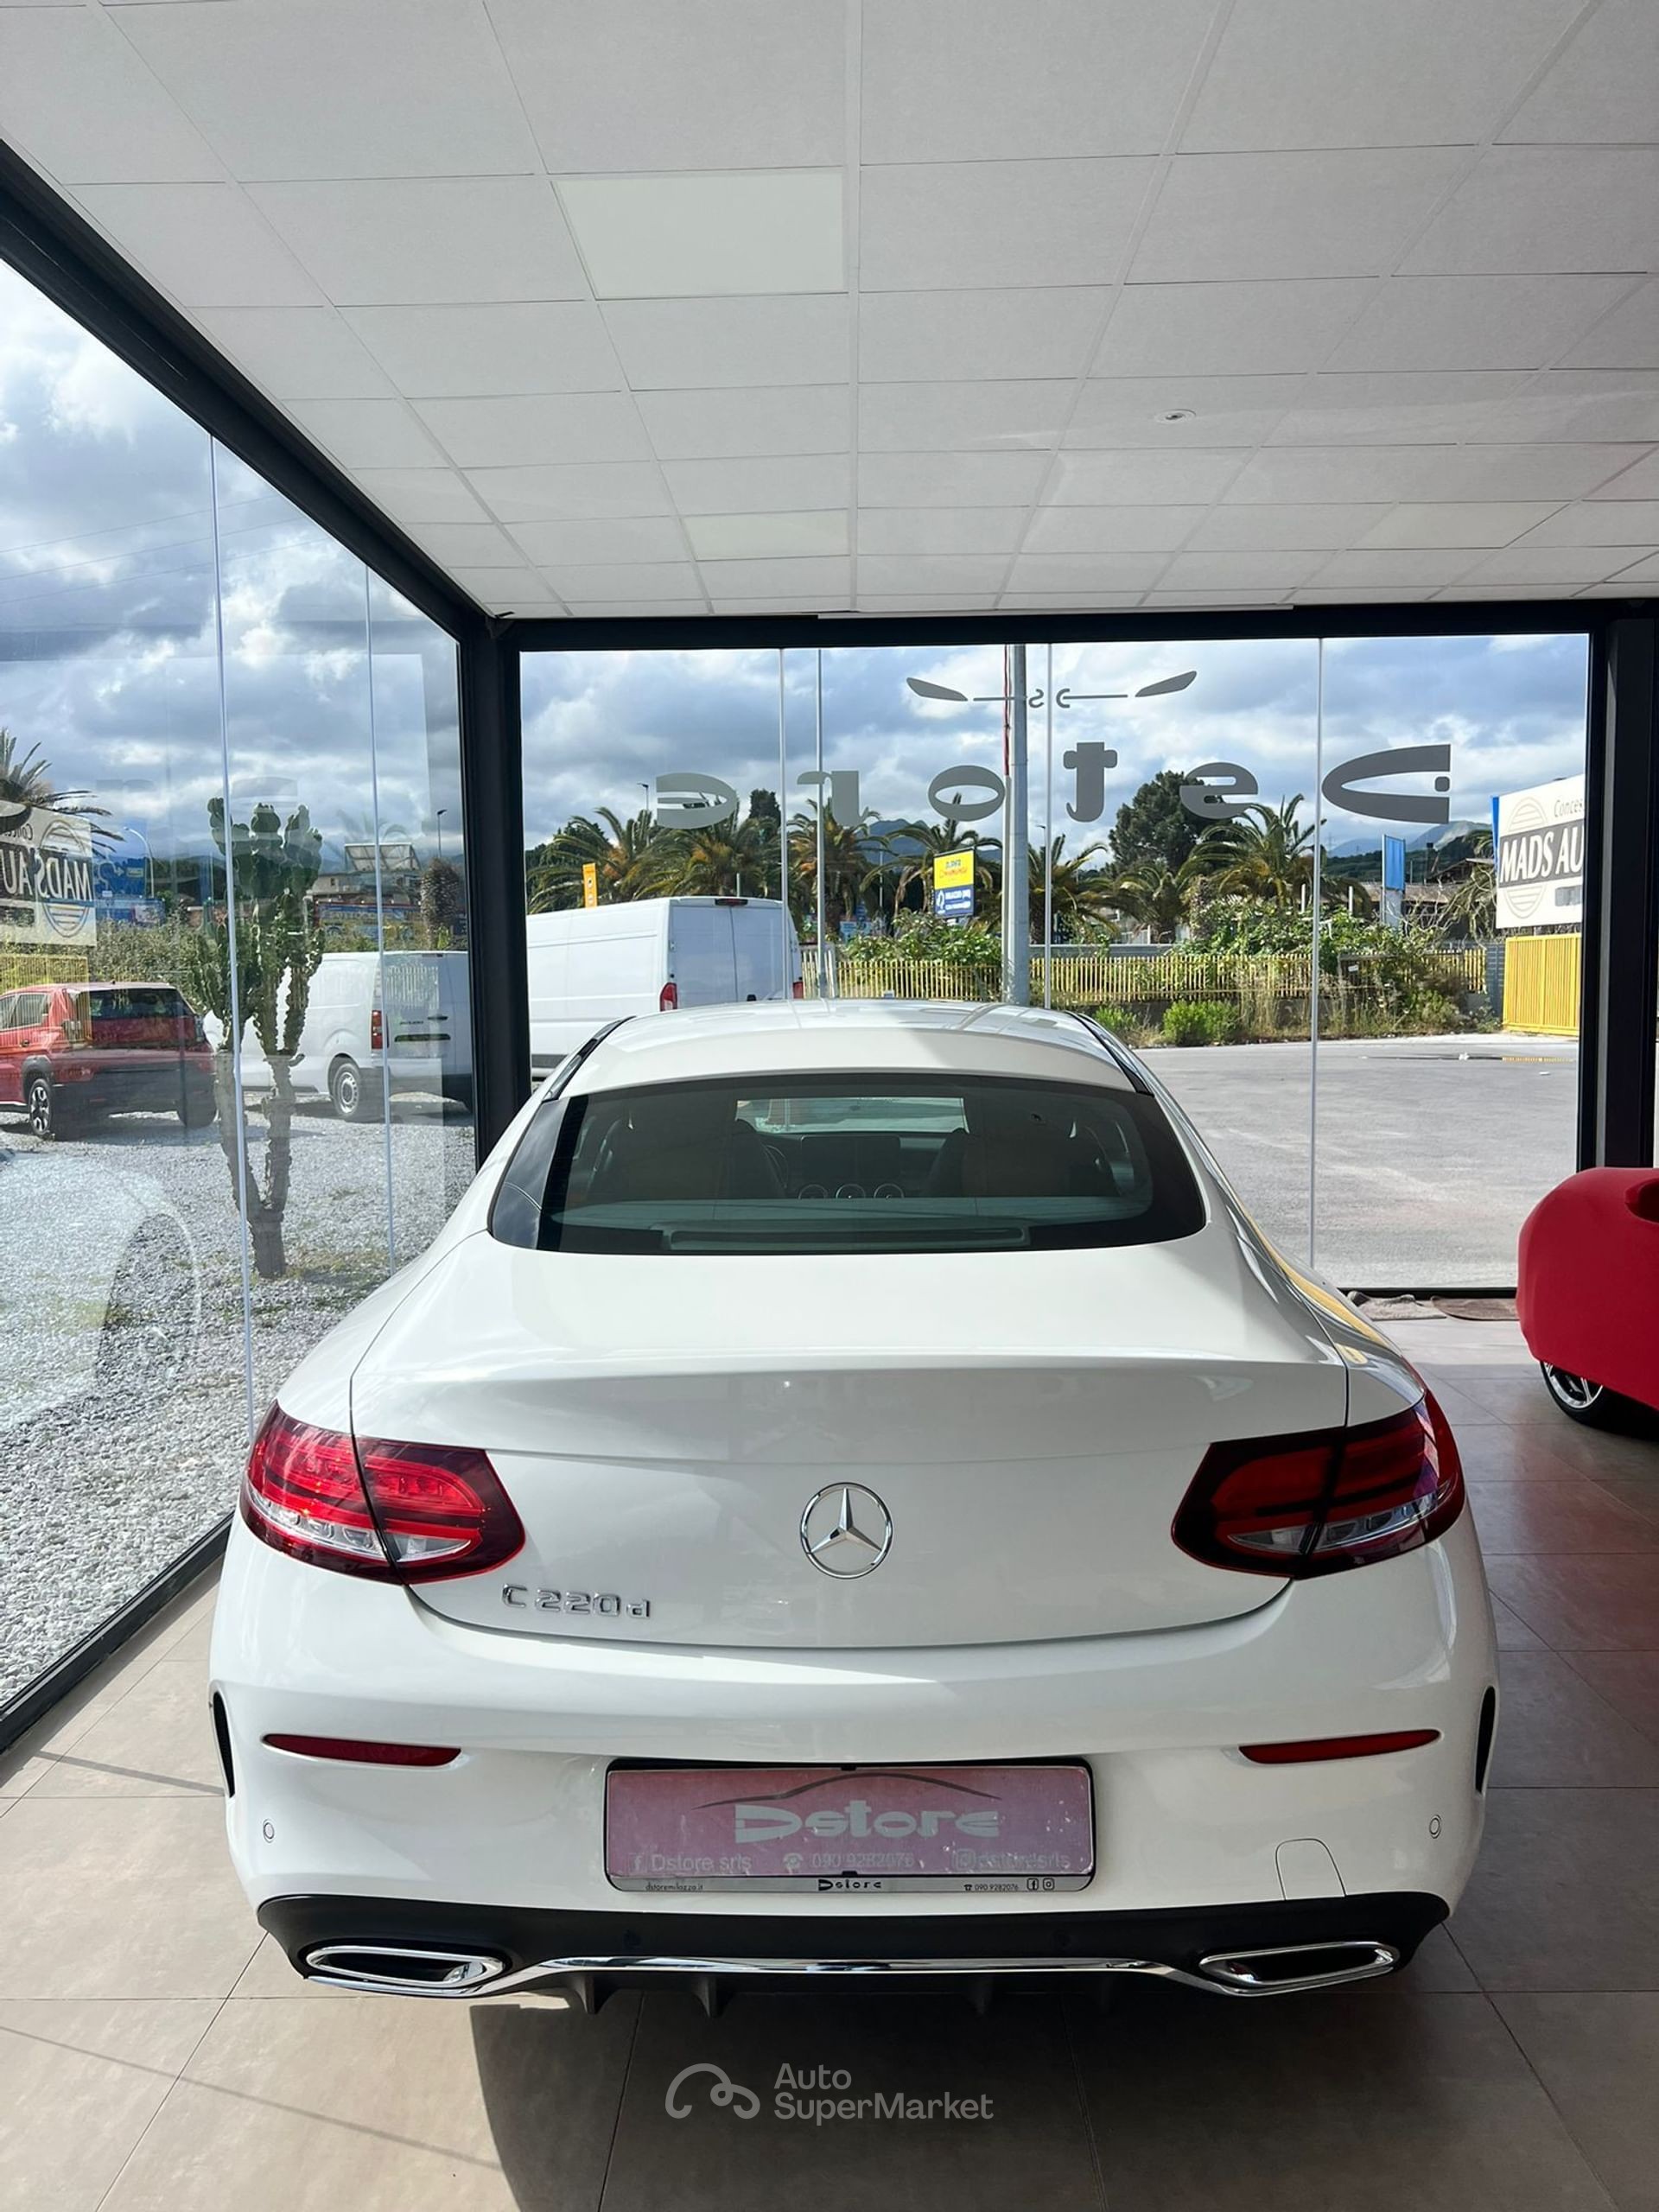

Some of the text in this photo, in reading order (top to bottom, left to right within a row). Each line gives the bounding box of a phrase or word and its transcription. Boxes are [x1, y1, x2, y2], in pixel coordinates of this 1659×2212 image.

[1499, 830, 1554, 884] MADS
[734, 1800, 1000, 1844] Dstore
[652, 1853, 714, 1872] Dstore
[817, 1878, 882, 1891] Dstore
[974, 1883, 988, 1891] 090
